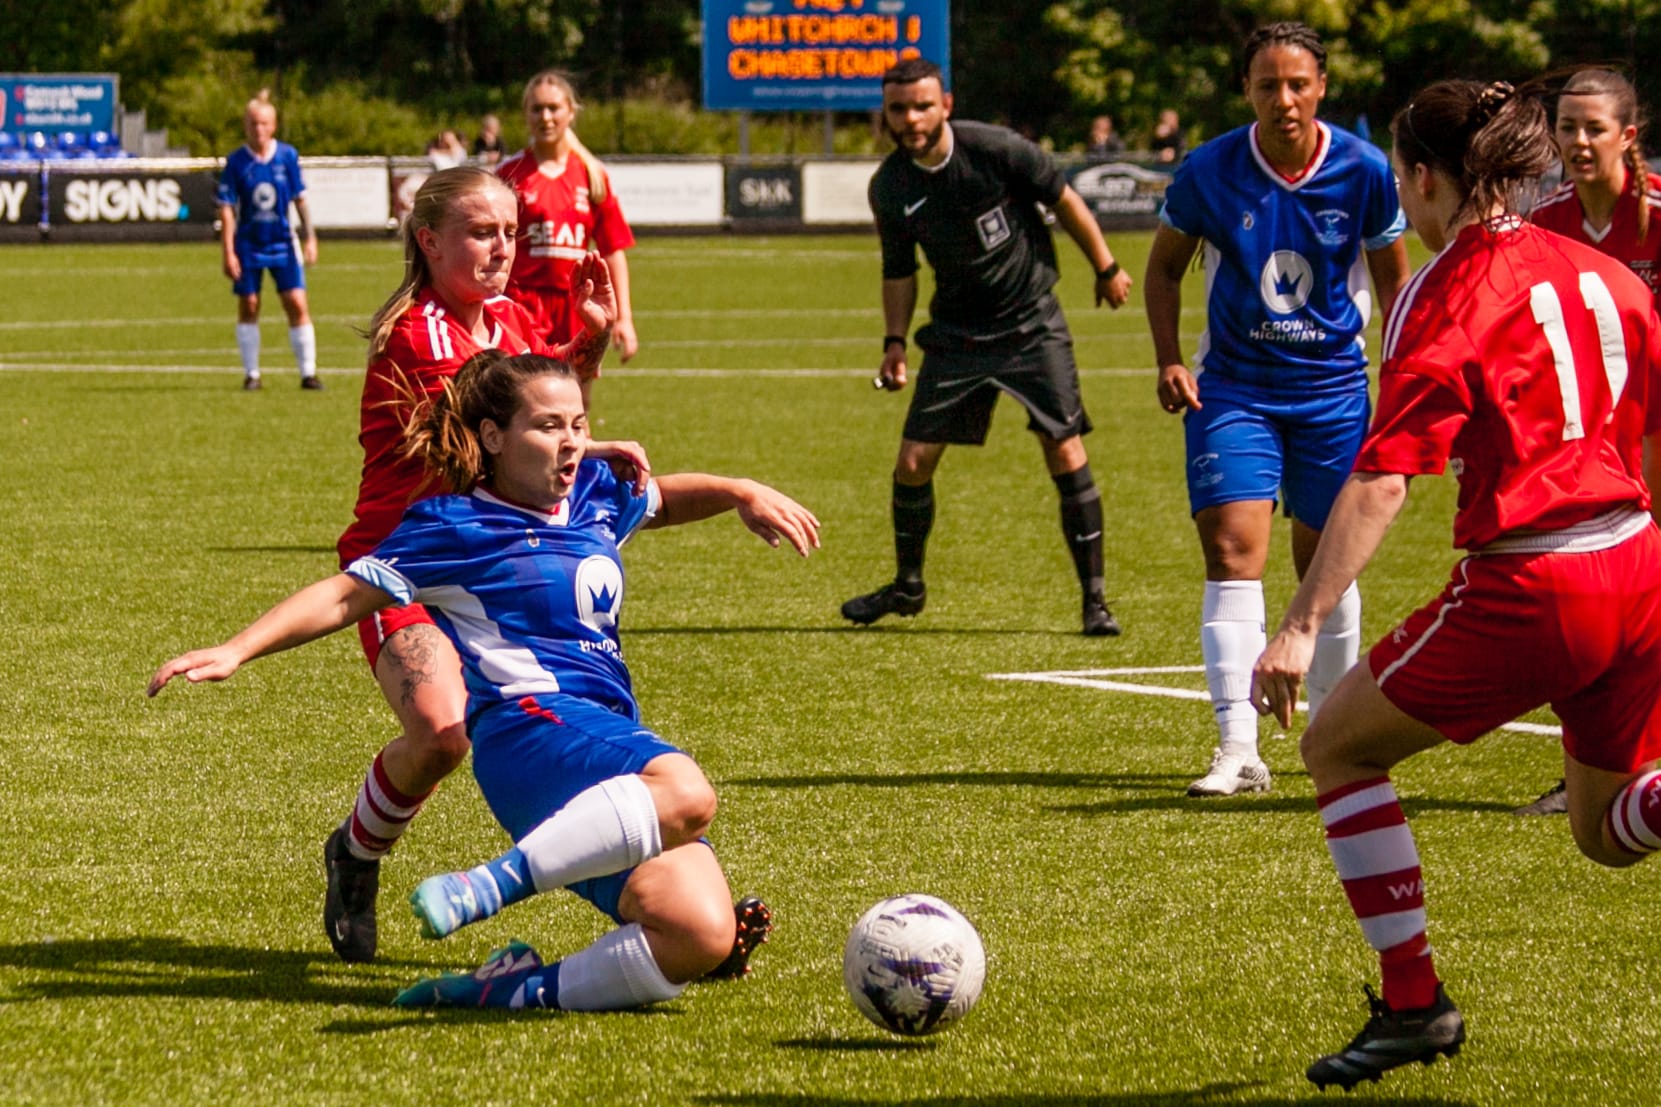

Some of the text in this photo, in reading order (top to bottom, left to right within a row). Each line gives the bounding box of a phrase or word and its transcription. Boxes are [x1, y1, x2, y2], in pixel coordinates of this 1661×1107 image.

[0, 180, 28, 222] Y
[1249, 328, 1327, 342] HIGHWAYS
[1261, 319, 1315, 332] CROWN
[1530, 271, 1629, 441] 11
